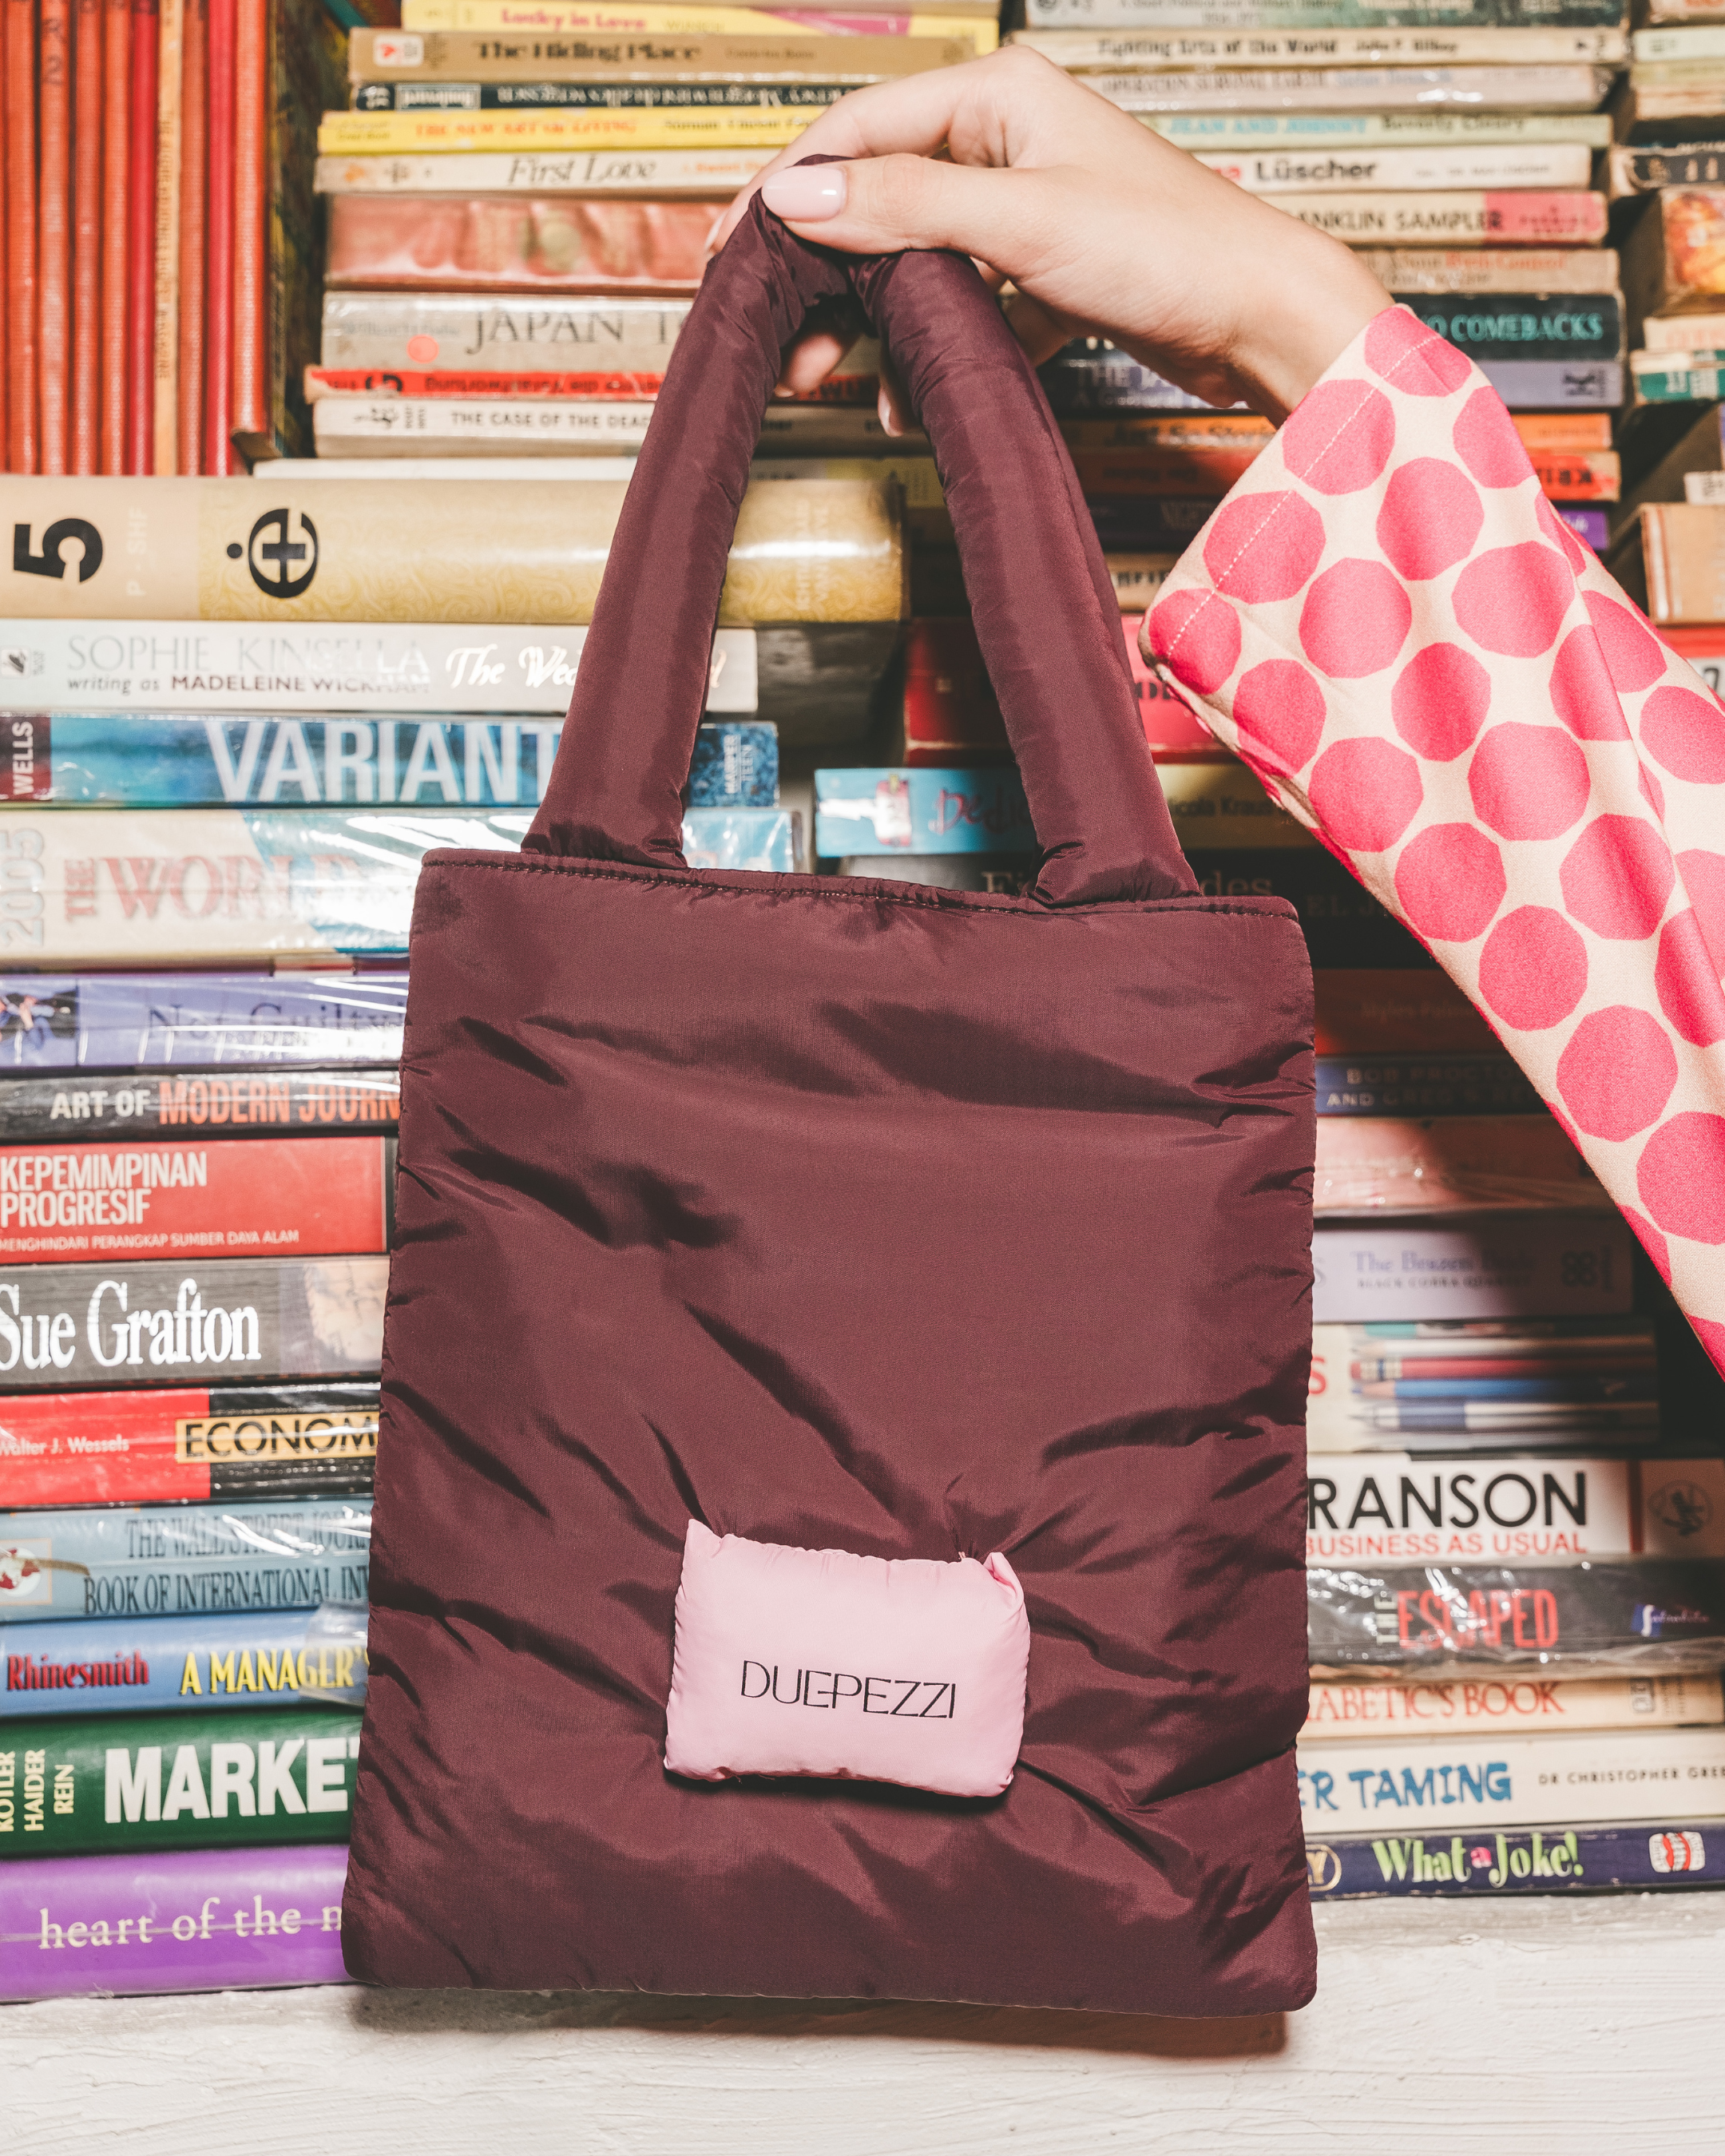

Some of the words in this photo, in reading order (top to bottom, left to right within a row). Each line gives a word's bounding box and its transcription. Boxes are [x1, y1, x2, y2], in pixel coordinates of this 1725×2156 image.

[476, 42, 527, 59] The
[508, 154, 580, 184] First
[585, 153, 657, 183] Love
[1255, 158, 1378, 184] Lüscher
[1395, 210, 1503, 232] SAMPLER
[465, 310, 624, 354] JAPAN
[1450, 312, 1604, 343] COMEBACKS
[451, 411, 483, 426] THE
[490, 412, 533, 426] CASE
[540, 413, 562, 427] OF
[569, 413, 600, 429] THE
[14, 517, 104, 584] 5
[67, 634, 212, 672] SOPHIE
[445, 644, 506, 689] The
[67, 675, 131, 696] writing
[139, 678, 161, 692] as
[171, 674, 307, 692] MADELEINE
[13, 721, 34, 795] WELLS
[1, 826, 46, 948] 2005
[64, 858, 97, 924] THE
[50, 1091, 109, 1120] ART
[115, 1088, 152, 1118] OF
[160, 1080, 290, 1125] MODERN
[1326, 1092, 1376, 1108] AND
[1, 1151, 208, 1192] KEPEMIMPINAN
[0, 1187, 153, 1228] PROGRESIF
[91, 1233, 169, 1250] PERANGKAP
[170, 1231, 225, 1247] SUMBER
[227, 1230, 260, 1245] DAYA
[261, 1229, 300, 1244] ALAM
[1349, 1249, 1393, 1273] The
[0, 1283, 77, 1371] Sue
[86, 1278, 262, 1368] Grafton
[0, 1437, 46, 1457] Walter
[51, 1438, 64, 1455] J.
[67, 1433, 130, 1455] Wessels
[184, 1416, 379, 1460] ECONOM
[1307, 1471, 1588, 1530] RANSON
[125, 1517, 167, 1559] THE
[1305, 1533, 1441, 1557] BUSINESS
[1446, 1532, 1484, 1556] AS
[1492, 1529, 1588, 1556] USUAL
[83, 1575, 141, 1616] BOOK
[143, 1572, 172, 1613] OF
[175, 1566, 337, 1612] INTERNATIONAL
[1397, 1588, 1560, 1651] ESAPED
[7, 1648, 150, 1692] Rhinesmith
[180, 1651, 203, 1696] A
[740, 1659, 957, 1719] DUEPEZZI
[1307, 1682, 1455, 1722] ABETIC'S
[1462, 1680, 1567, 1718] BOOK
[24, 1749, 46, 1832] HAIDER
[54, 1764, 75, 1814] REIN
[1347, 1761, 1513, 1810] TAMING
[1538, 1772, 1560, 1786] DR
[1566, 1766, 1680, 1785] CHRISTOPHER
[1370, 1836, 1473, 1884] What
[1470, 1845, 1493, 1869] a
[1488, 1829, 1585, 1889] Joke!
[38, 1908, 153, 1950] heart
[171, 1896, 221, 1942] of
[232, 1893, 303, 1938] the
